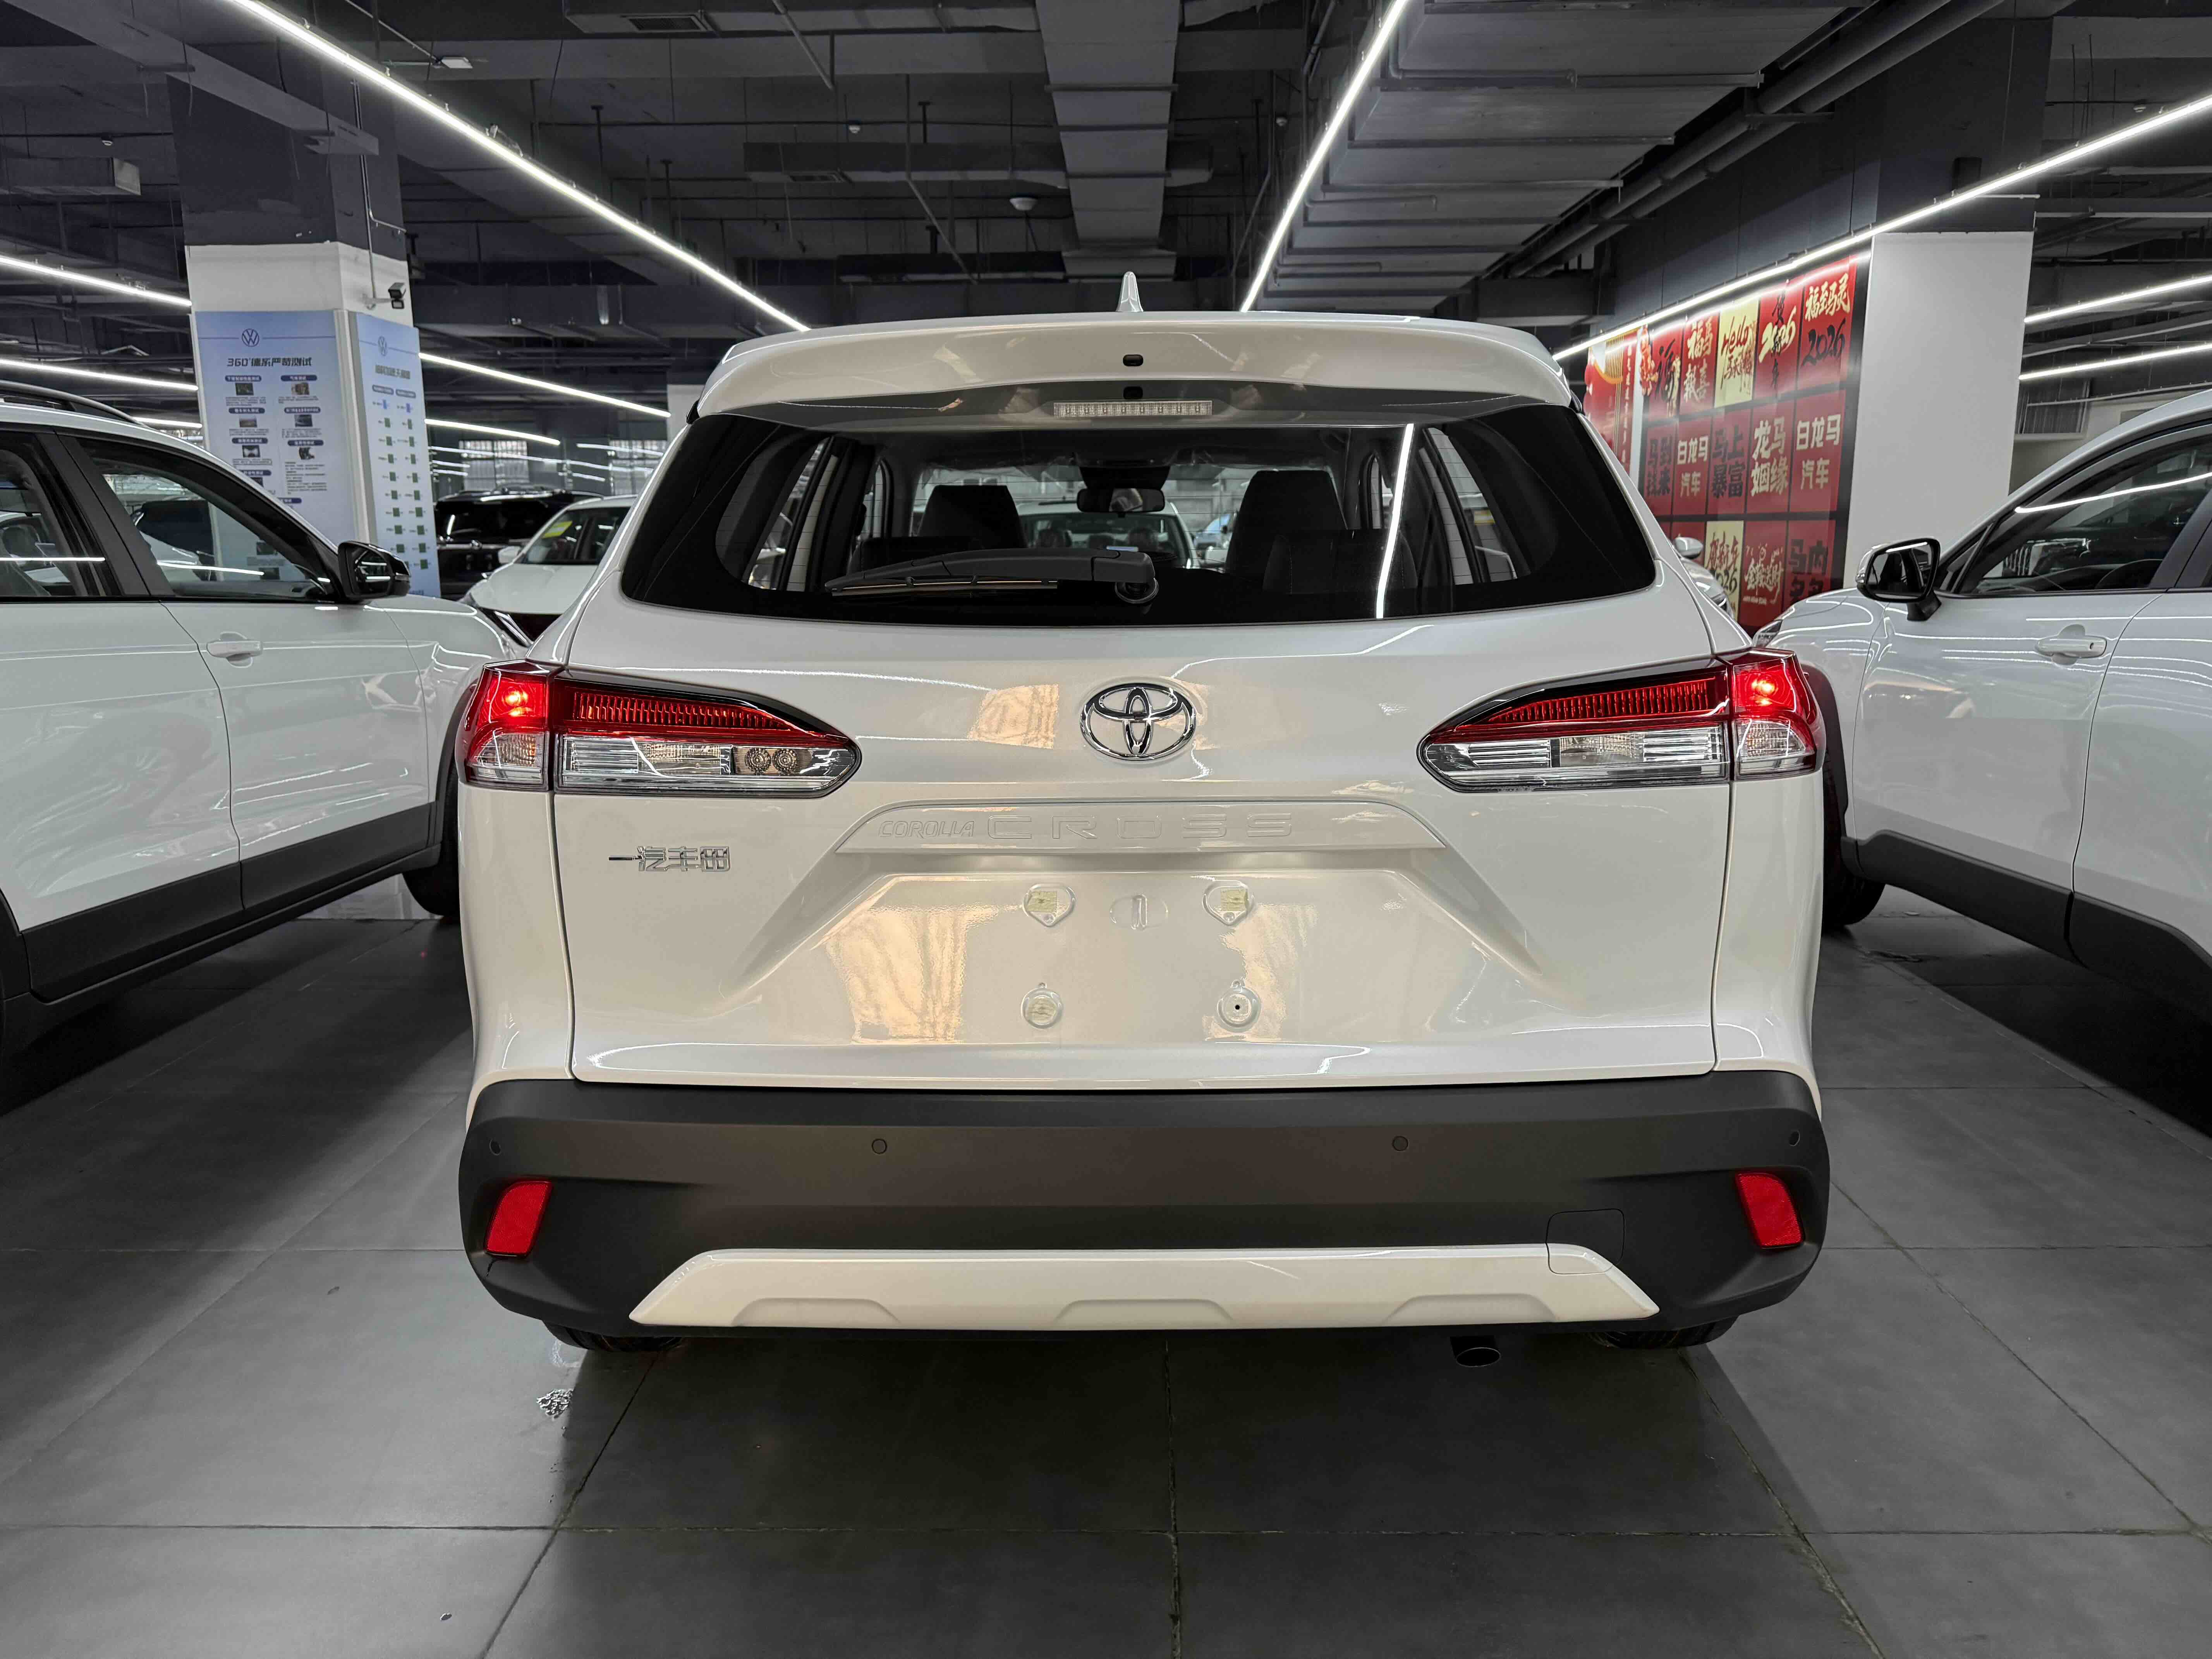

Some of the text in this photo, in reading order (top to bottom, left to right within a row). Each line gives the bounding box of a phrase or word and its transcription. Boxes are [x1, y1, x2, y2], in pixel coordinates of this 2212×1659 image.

[1802, 318, 1846, 366] 2026
[1752, 416, 1786, 460] 龙马
[1796, 414, 1841, 450] 白龙马
[1677, 435, 1709, 465] 白龙马
[1680, 471, 1701, 498] 汽车
[1751, 456, 1788, 497] 姻缘
[1801, 457, 1830, 490] 汽车
[878, 812, 1292, 840] COROLLA CROSS
[608, 846, 731, 872] 一汽丰田
